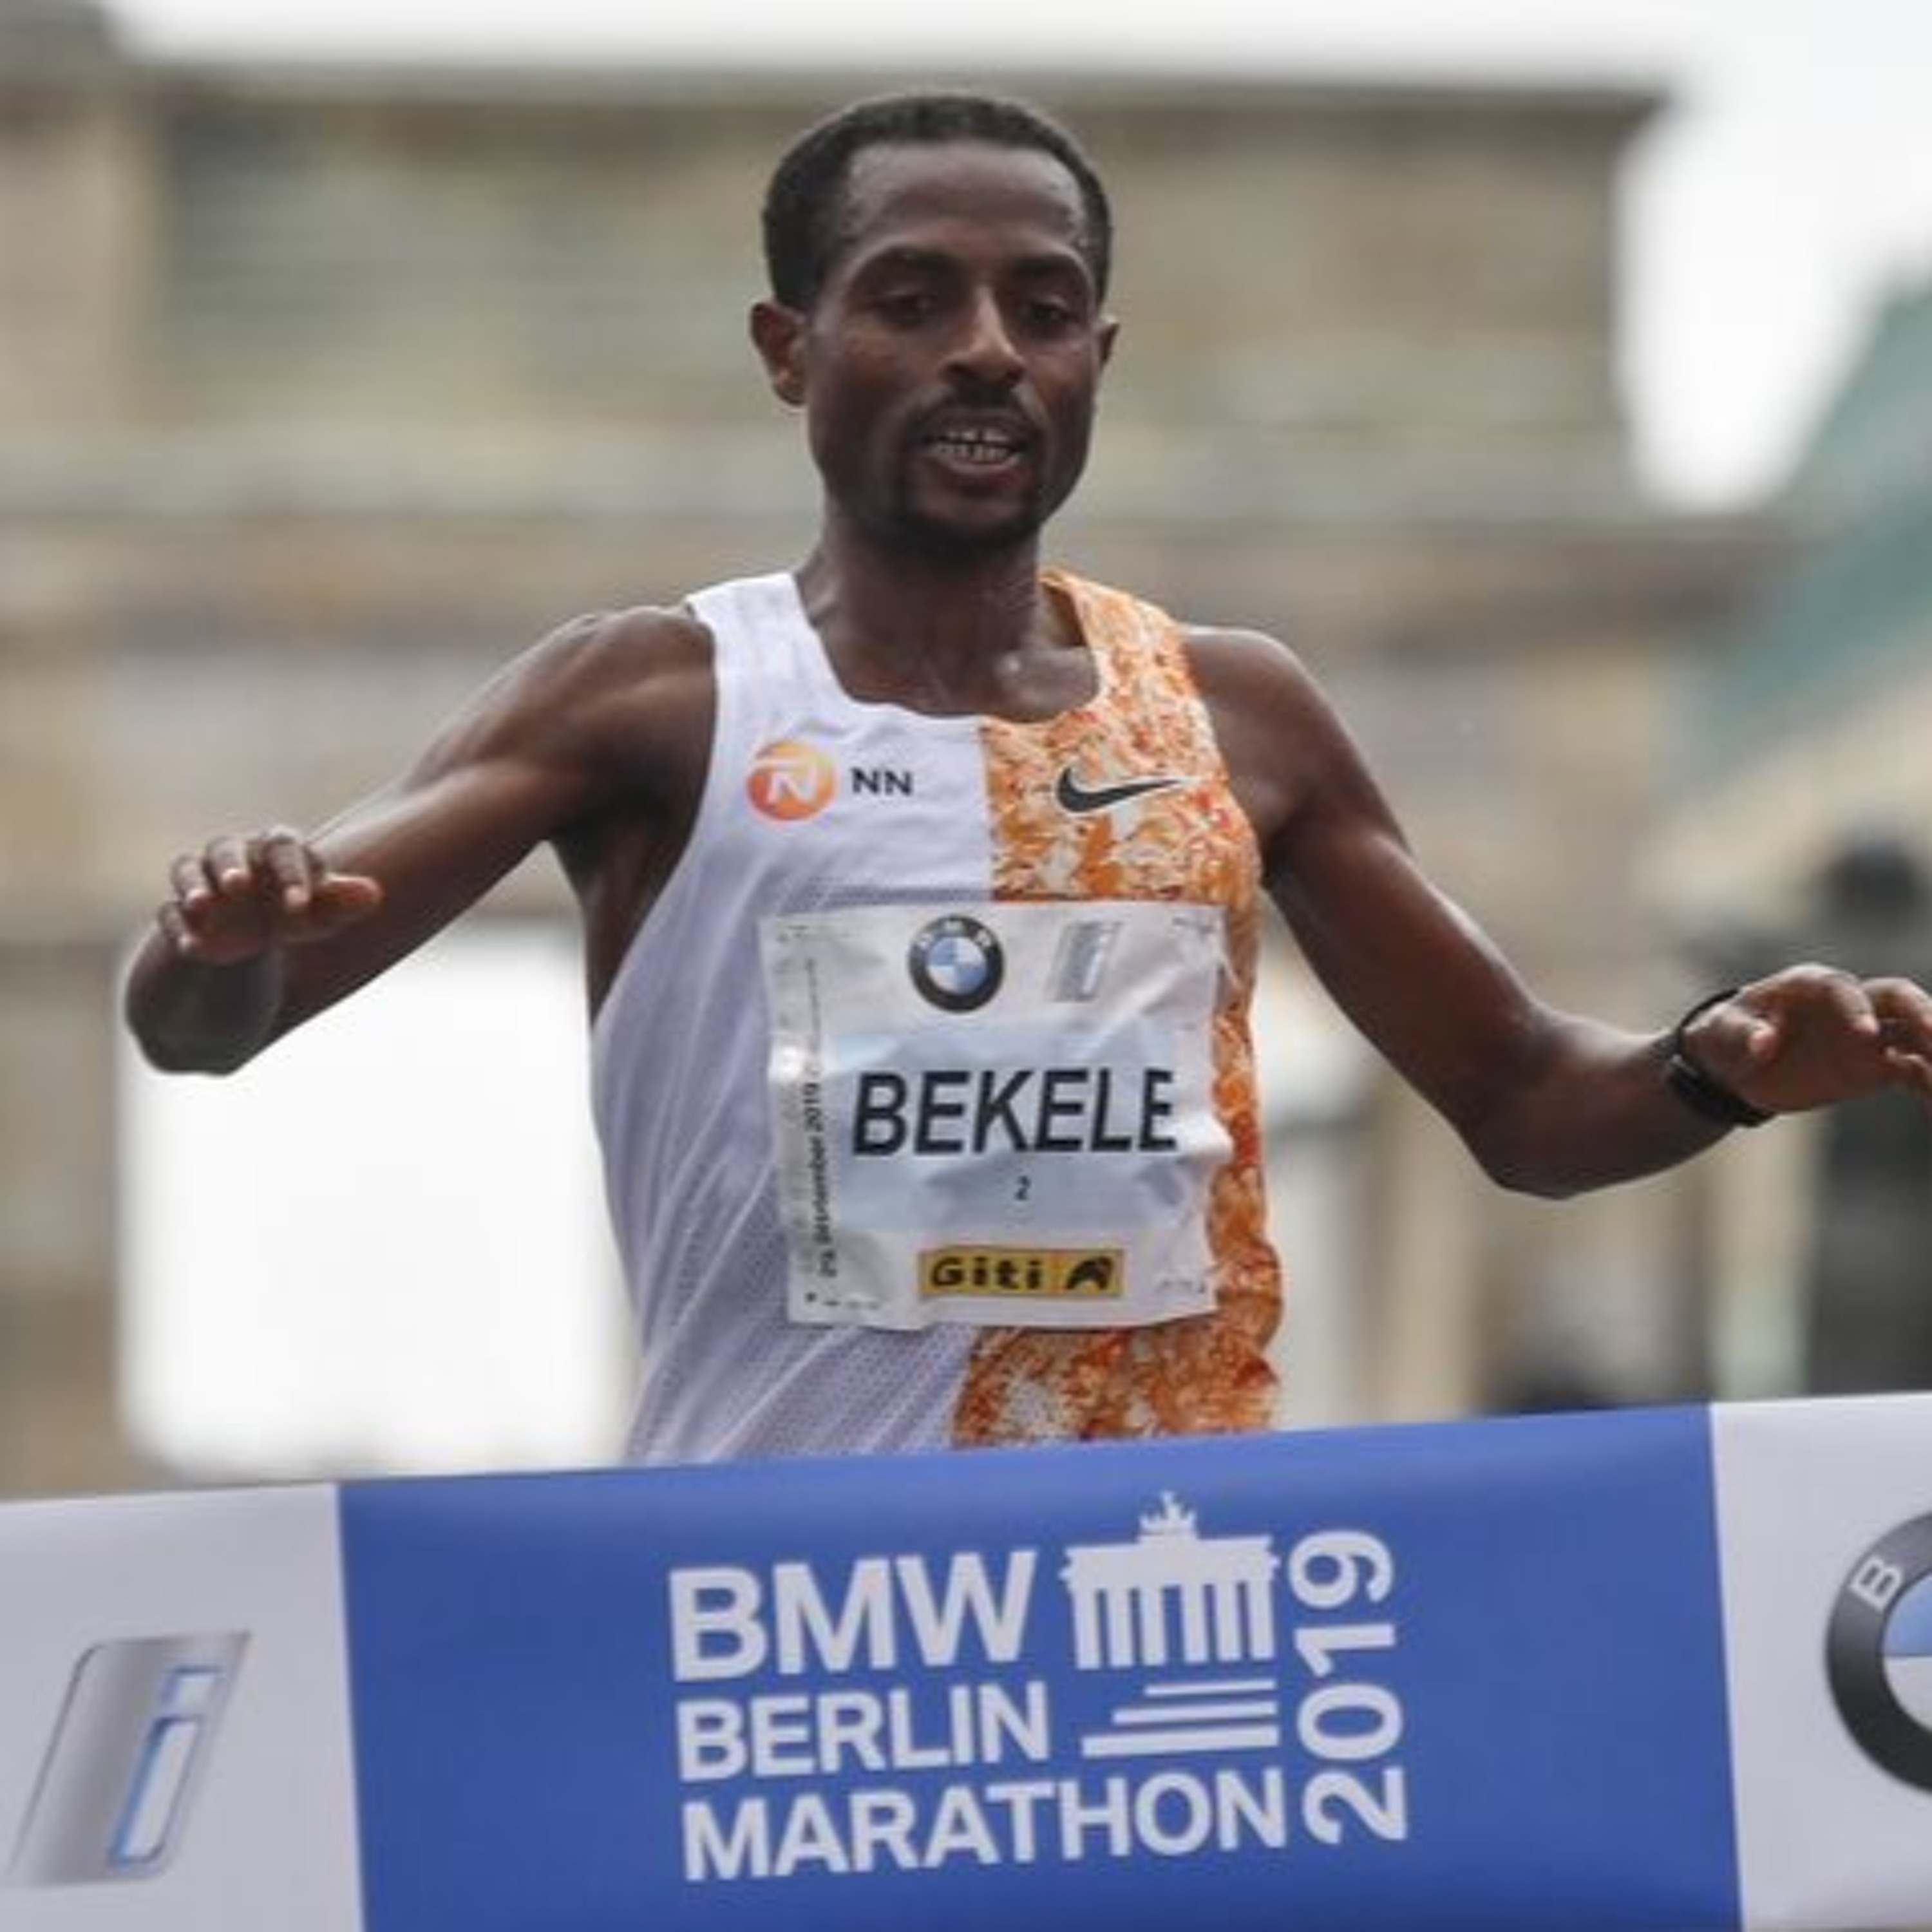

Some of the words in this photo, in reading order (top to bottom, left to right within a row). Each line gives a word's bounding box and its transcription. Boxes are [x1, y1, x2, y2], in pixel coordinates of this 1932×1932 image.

[850, 766, 913, 797] NN
[803, 1082, 823, 1133] 2019
[853, 1068, 1177, 1157] BEKELE
[1014, 1175, 1031, 1200] 2
[931, 1256, 1041, 1290] Giti
[668, 1549, 1036, 1682] BMW
[677, 1681, 1050, 1782] BERLIN
[1289, 1530, 1407, 1844] 2019
[683, 1767, 1287, 1882] MARATHON
